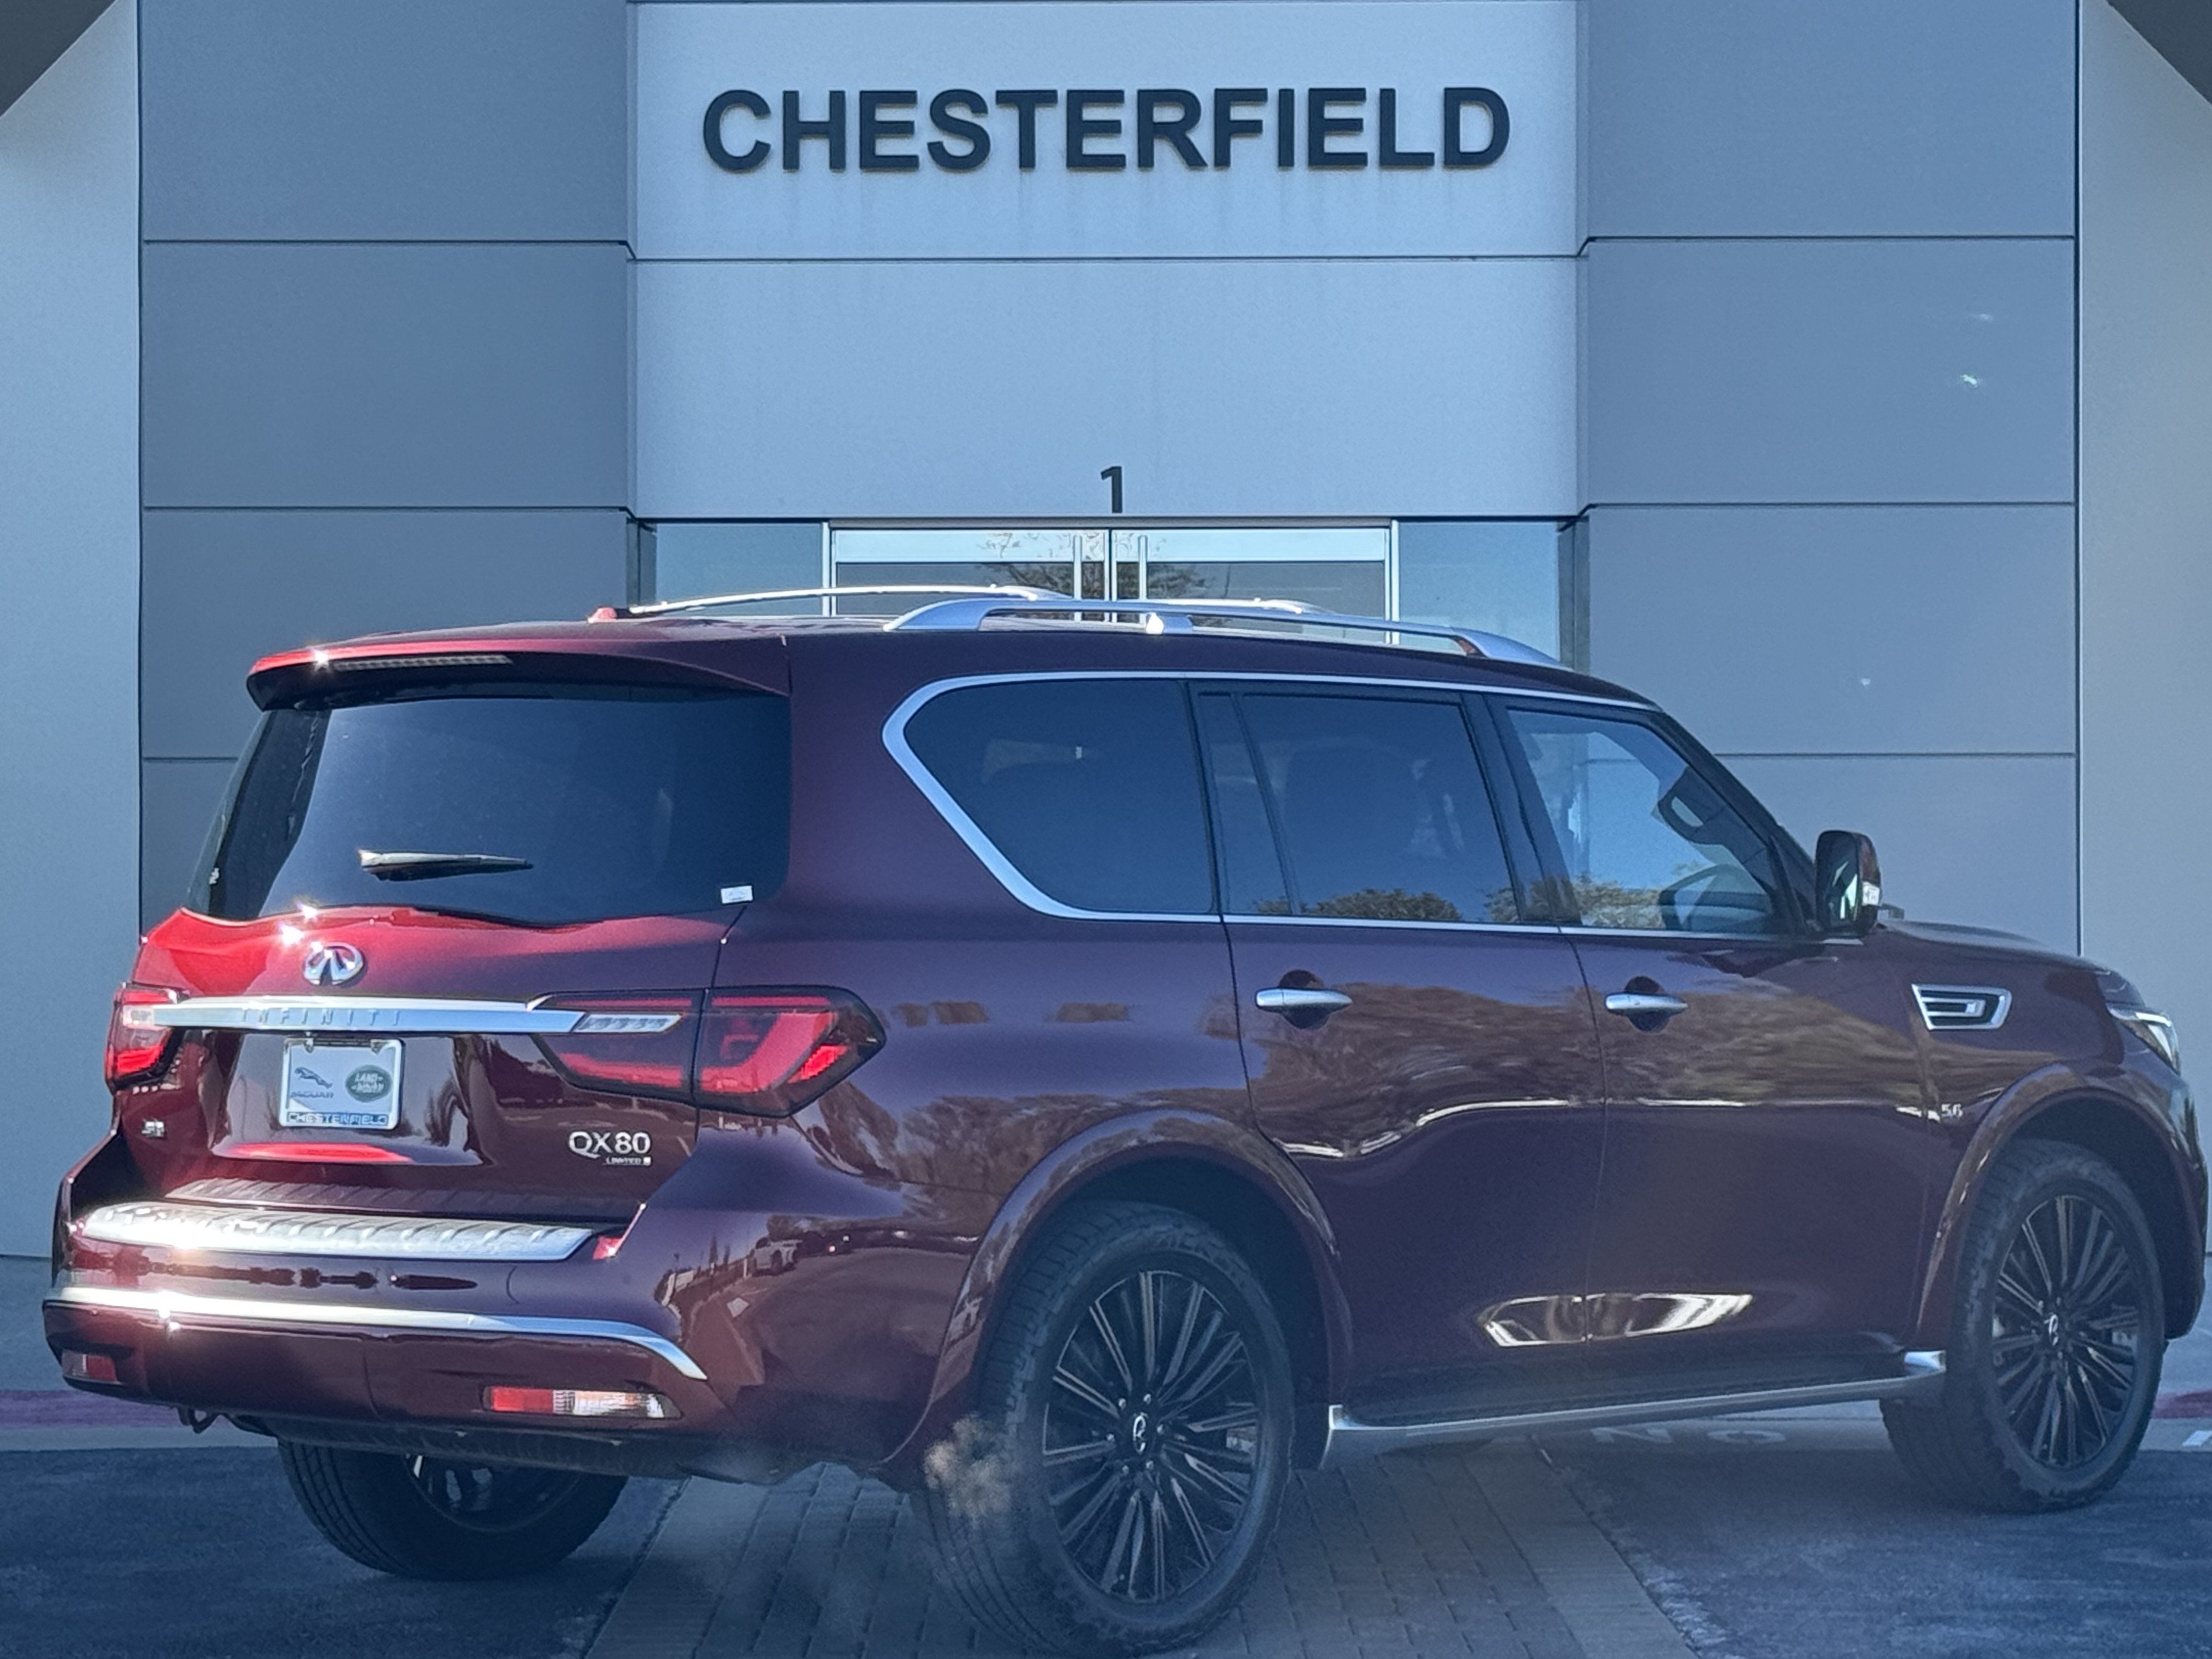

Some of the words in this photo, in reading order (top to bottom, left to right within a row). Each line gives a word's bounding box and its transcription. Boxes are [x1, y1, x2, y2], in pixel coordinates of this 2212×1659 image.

[703, 87, 1512, 172] CHESTERFIELD
[1100, 466, 1123, 514] 1
[242, 1007, 401, 1026] INFINITI
[289, 1113, 388, 1125] CHESTERFIELD
[568, 1131, 651, 1160] QX80
